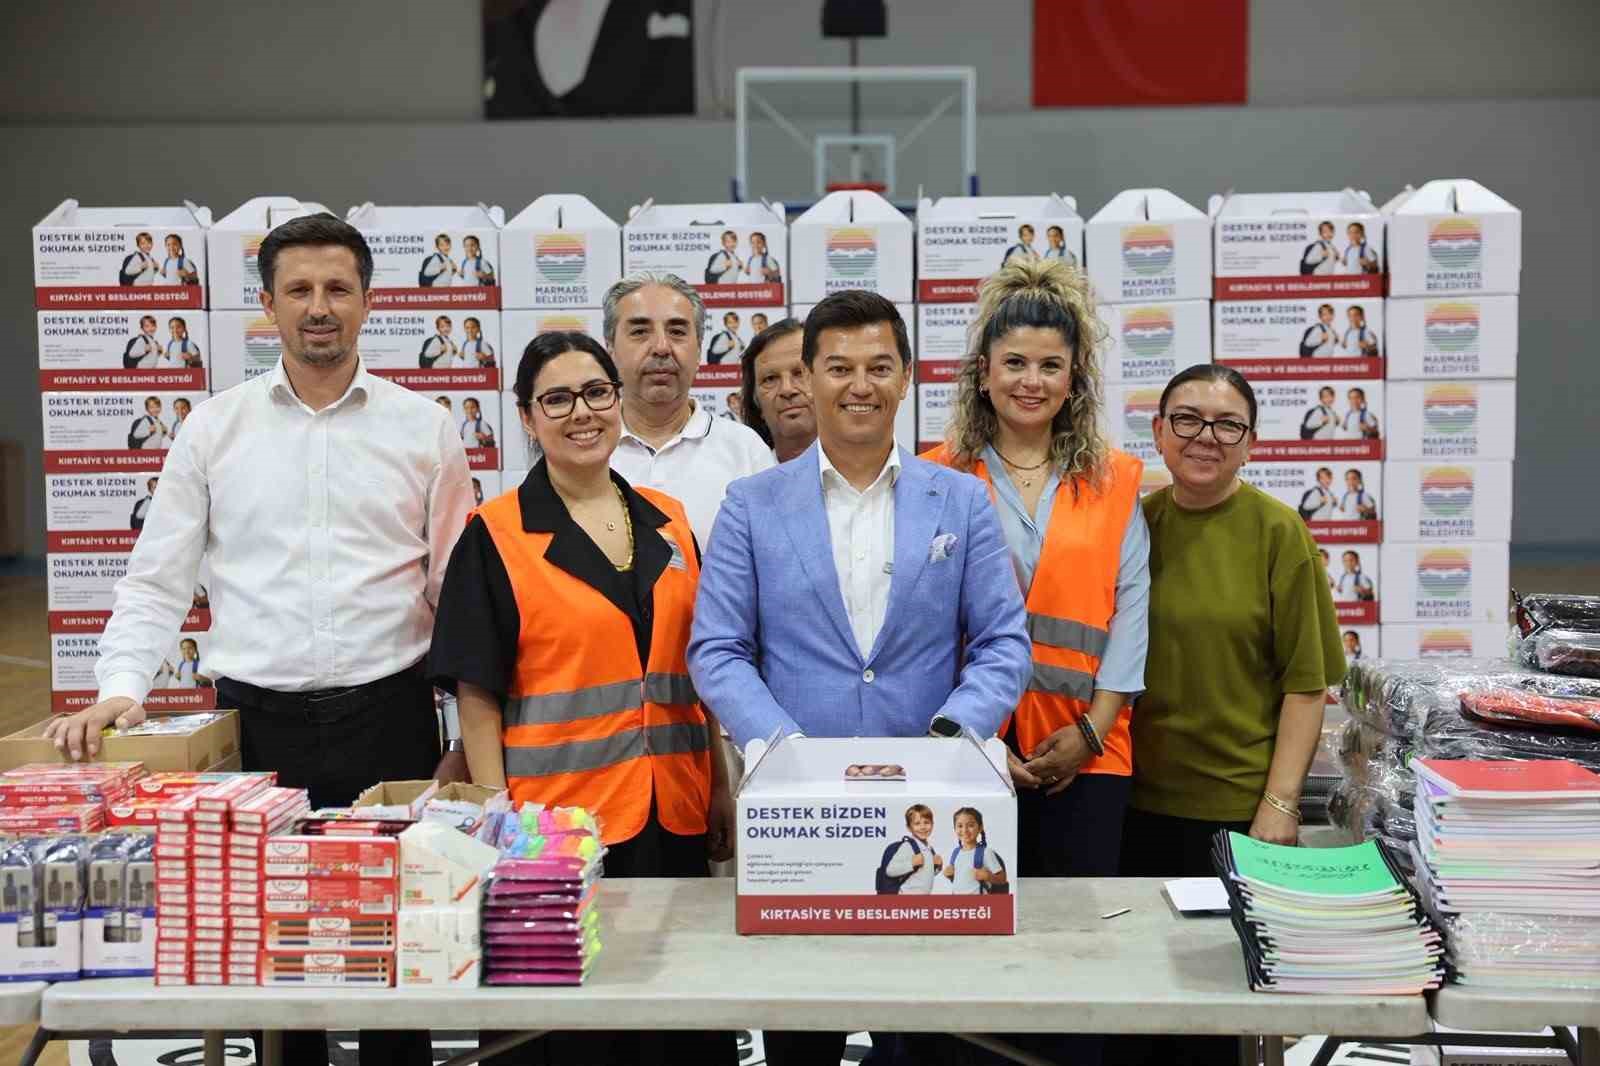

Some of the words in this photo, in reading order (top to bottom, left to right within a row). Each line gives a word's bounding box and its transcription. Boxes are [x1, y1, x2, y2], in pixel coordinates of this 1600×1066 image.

[925, 226, 965, 234] DESTEK
[968, 224, 1007, 234] BİZDEN
[39, 234, 81, 242] DESTEK
[84, 231, 125, 241] BİZDEN
[385, 234, 424, 244] BİZDEN
[628, 232, 669, 241] DESTEK
[672, 230, 711, 240] BİZDEN
[925, 237, 969, 246] OKUMAK
[971, 235, 1007, 245] SİZDEN
[40, 244, 86, 254] OKUMAK
[88, 242, 126, 252] SİZDEN
[388, 245, 424, 255] SİZDEN
[629, 244, 673, 252] OKUMAK
[675, 242, 711, 252] SİZDEN
[826, 280, 878, 288] MARMARİS
[536, 285, 588, 294] MARMARİS
[738, 289, 772, 298] DESTEĞİ
[50, 292, 92, 302] KIRTASİYE
[95, 293, 106, 302] VE
[108, 293, 152, 302] BESLENME
[154, 291, 190, 301] DESTEĞİ
[452, 292, 487, 302] DESTEĞİ
[536, 295, 588, 304] BELEDİYESİ
[925, 308, 965, 316] DESTEK
[44, 317, 85, 325] DESTEK
[88, 315, 129, 325] BİZDEN
[386, 316, 425, 324] BİZDEN
[44, 328, 90, 337] OKUMAK
[92, 326, 129, 336] SİZDEN
[389, 326, 425, 336] SİZDEN
[53, 374, 96, 384] KIRTASİYE
[98, 376, 110, 384] VE
[112, 376, 155, 384] BESLENME
[157, 373, 193, 384] DESTEĞİ
[451, 374, 487, 383] DESTEĞİ
[48, 398, 90, 406] DESTEK
[93, 396, 133, 406] BİZDEN
[48, 409, 94, 417] OKUMAK
[96, 407, 134, 417] SİZDEN
[58, 455, 102, 465] KIRTASİYE
[96, 477, 136, 486] BİZDEN
[99, 488, 136, 497] SİZDEN
[61, 536, 104, 545] KIRTASİYE
[98, 558, 128, 566] BİZDE
[62, 616, 104, 625] KIRTASİYE
[169, 695, 203, 704] DESTEĞİ
[746, 807, 815, 820] DESTEK
[820, 804, 886, 819] BİZDEN
[746, 826, 821, 839] OKUMAK
[825, 823, 887, 838] SİZDEN
[760, 906, 831, 920] KIRTASİYE
[835, 908, 854, 920] VE
[857, 908, 928, 920] BESLENME
[932, 905, 992, 920] DESTEĞİ
